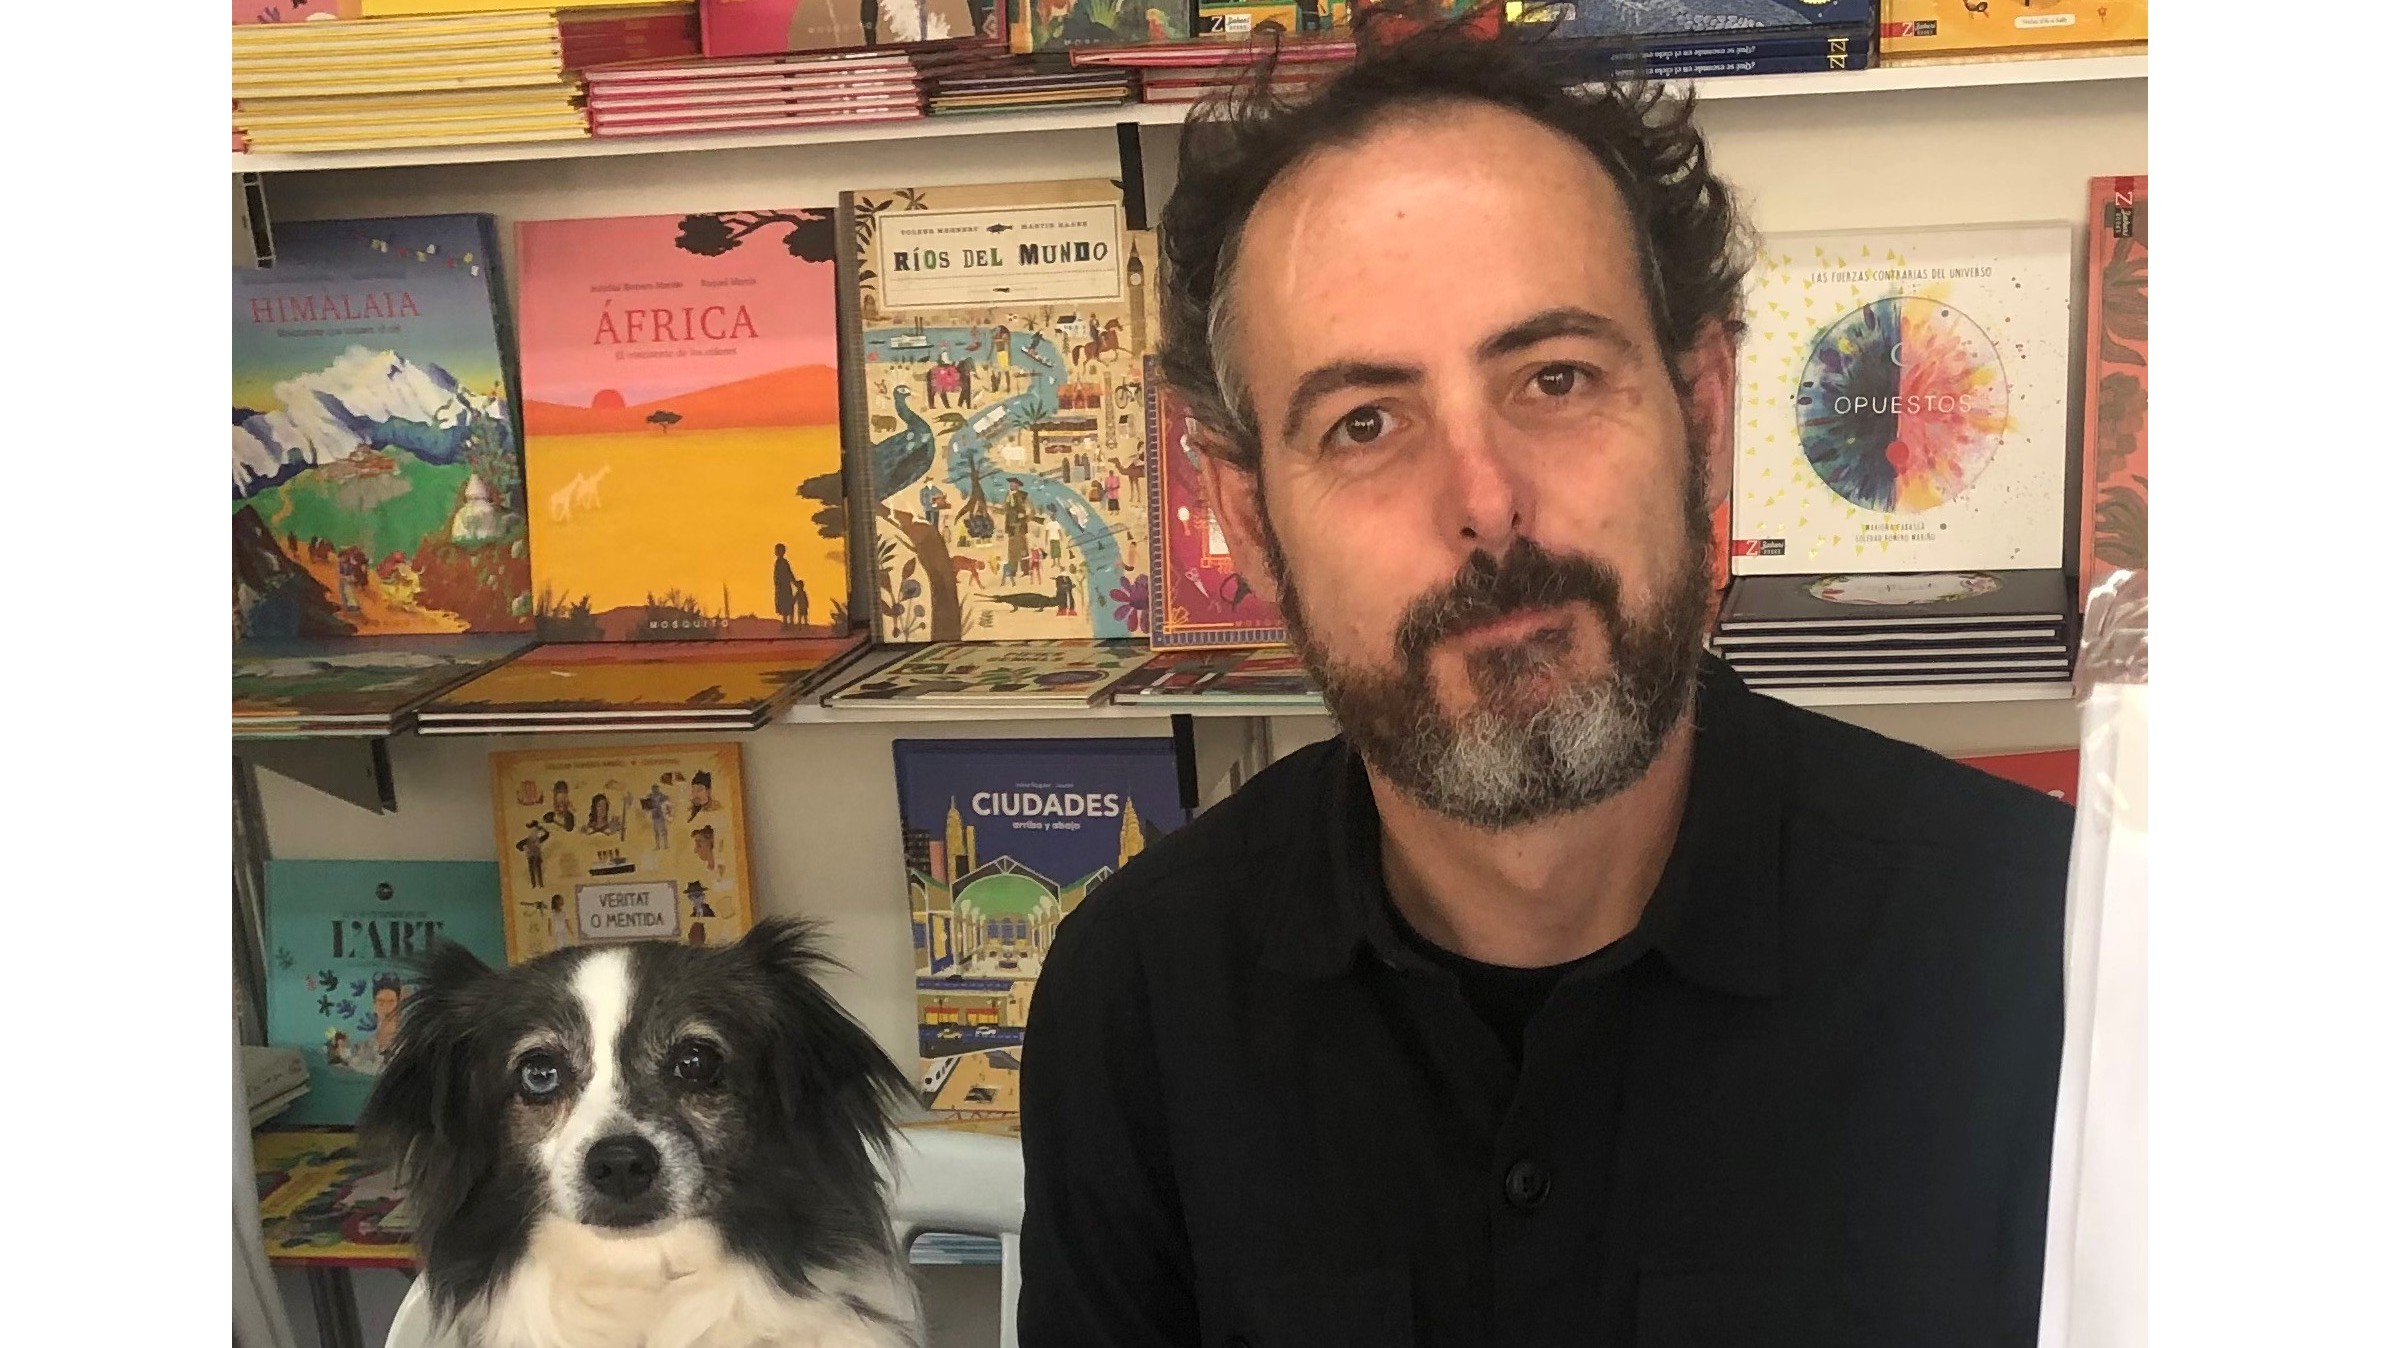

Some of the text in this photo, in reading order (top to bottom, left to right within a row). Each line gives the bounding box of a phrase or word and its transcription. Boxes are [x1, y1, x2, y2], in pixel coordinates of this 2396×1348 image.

[1211, 16, 1224, 32] Z
[1902, 22, 1913, 37] Z
[2115, 191, 2133, 206] Z
[894, 241, 1108, 271] RÍOS DEL MUNDO
[1811, 266, 1992, 283] LAS FUERZAS CONTRARIAS DEL UNIVERSO
[594, 299, 759, 345] ÁFRICA
[1834, 394, 1973, 415] OPUESTOS
[1746, 540, 1758, 556] Z
[971, 792, 1120, 818] CIUDADES
[1012, 821, 1081, 831] arriba y abajo
[599, 892, 650, 908] VERITAT
[591, 912, 665, 928] O MENTIDA
